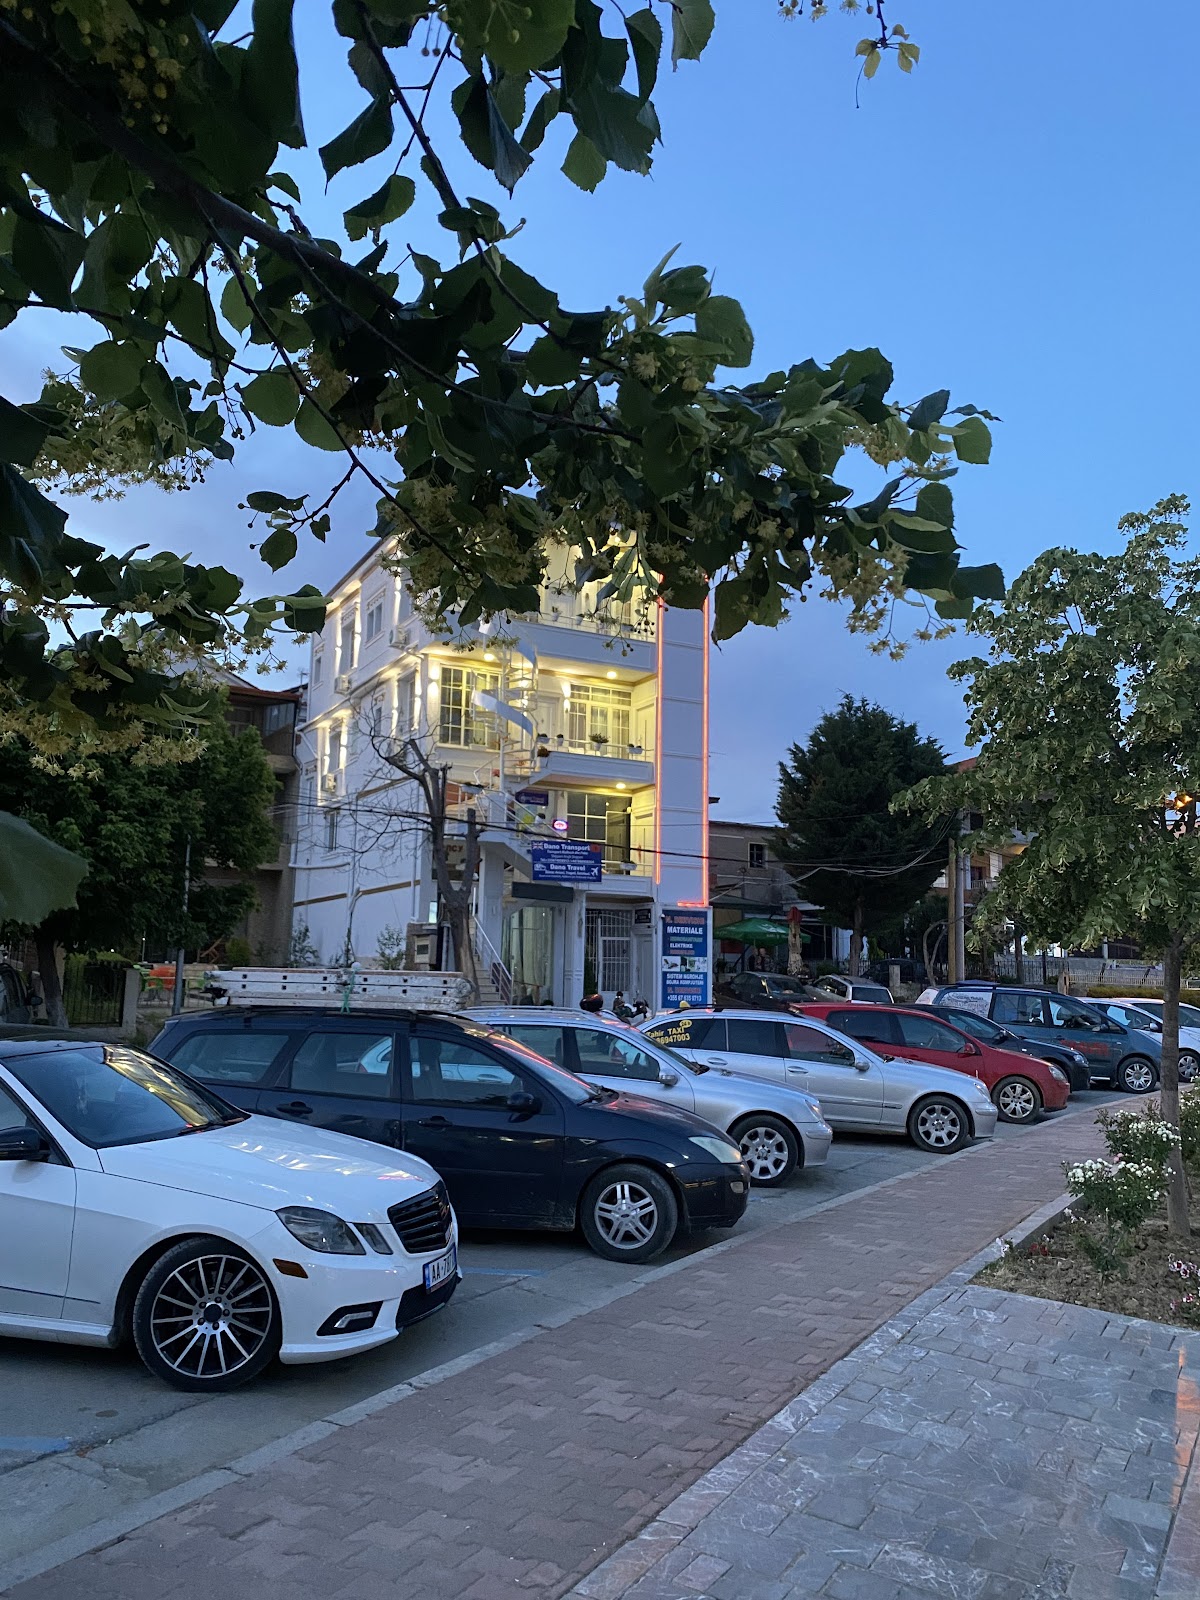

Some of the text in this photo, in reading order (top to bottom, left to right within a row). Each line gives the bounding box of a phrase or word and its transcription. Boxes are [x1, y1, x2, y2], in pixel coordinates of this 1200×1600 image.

[561, 843, 590, 851] Transport
[666, 926, 704, 935] MATERIALE
[667, 1025, 685, 1035] TAXI
